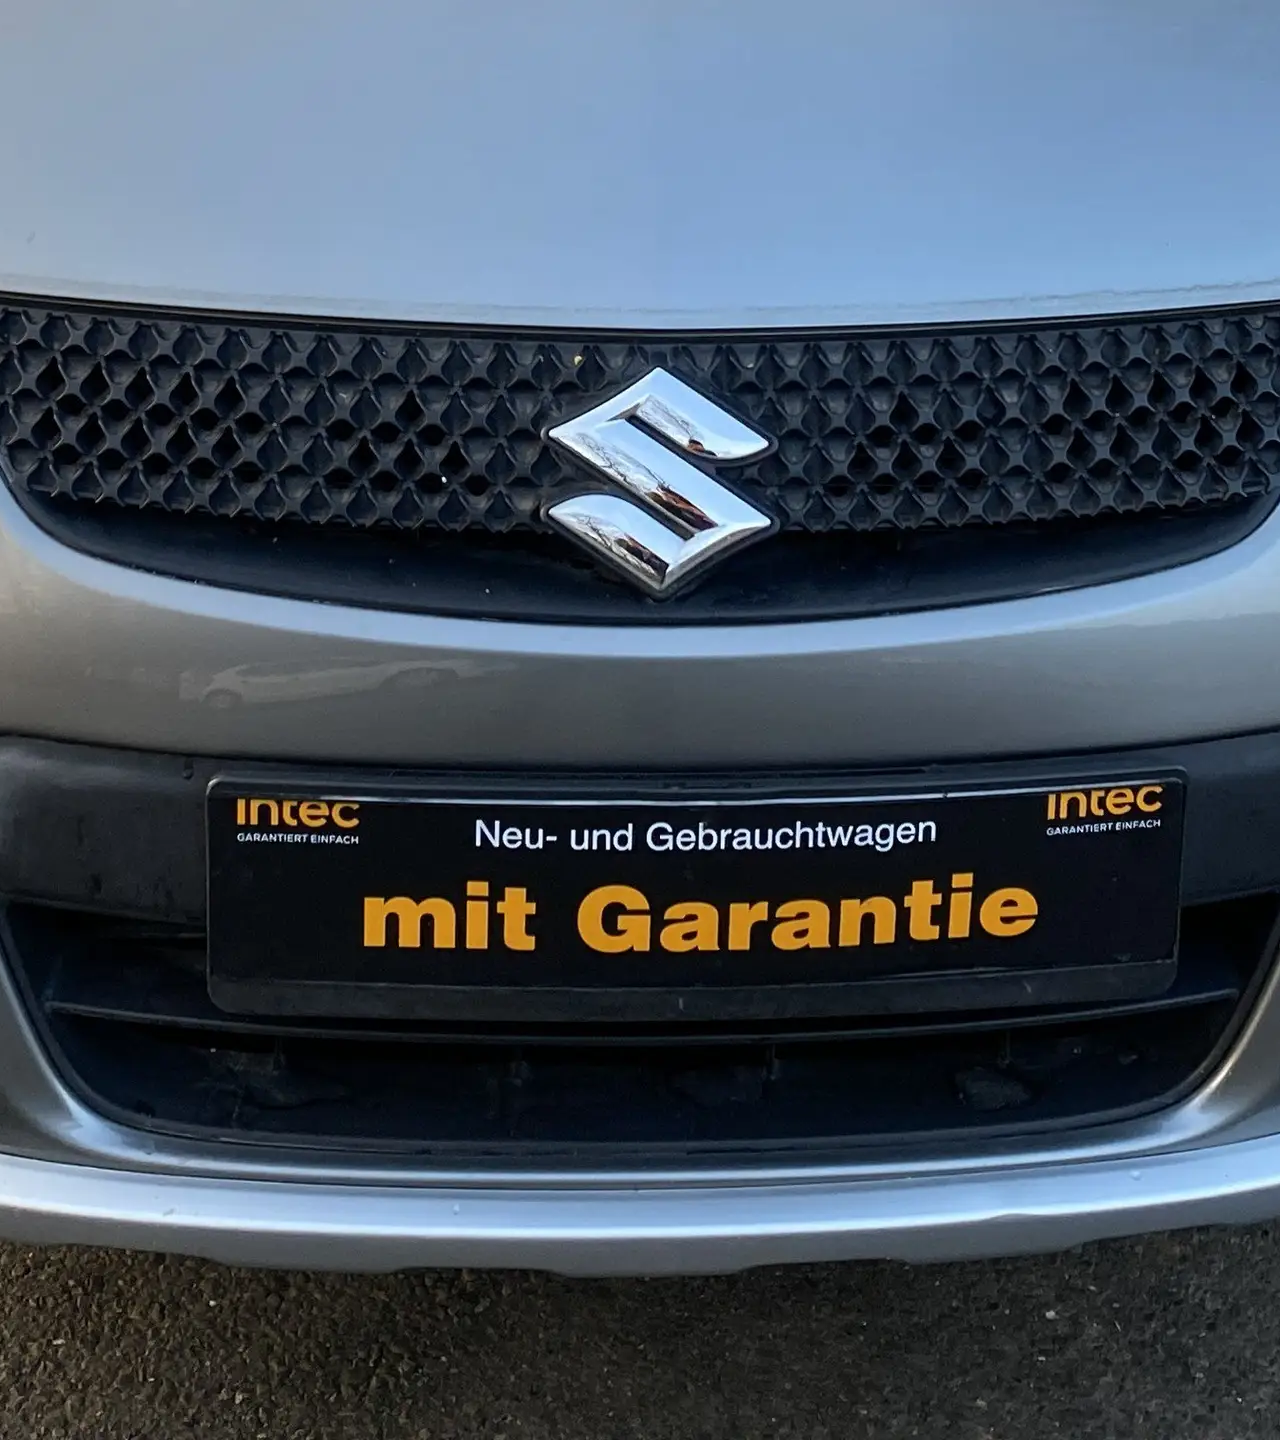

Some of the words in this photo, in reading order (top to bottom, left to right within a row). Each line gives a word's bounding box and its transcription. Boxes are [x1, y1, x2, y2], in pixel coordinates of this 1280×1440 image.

[236, 832, 309, 844] GARANTIERT
[310, 834, 360, 845] EINFACH
[475, 819, 558, 850] Neu-
[570, 822, 633, 851] und
[646, 820, 937, 852] Gebrauchtwagen
[1046, 822, 1113, 836] GARANTIERT
[1115, 819, 1161, 831] EINFACH
[364, 880, 537, 951] mit
[577, 872, 1039, 953] Garantie
